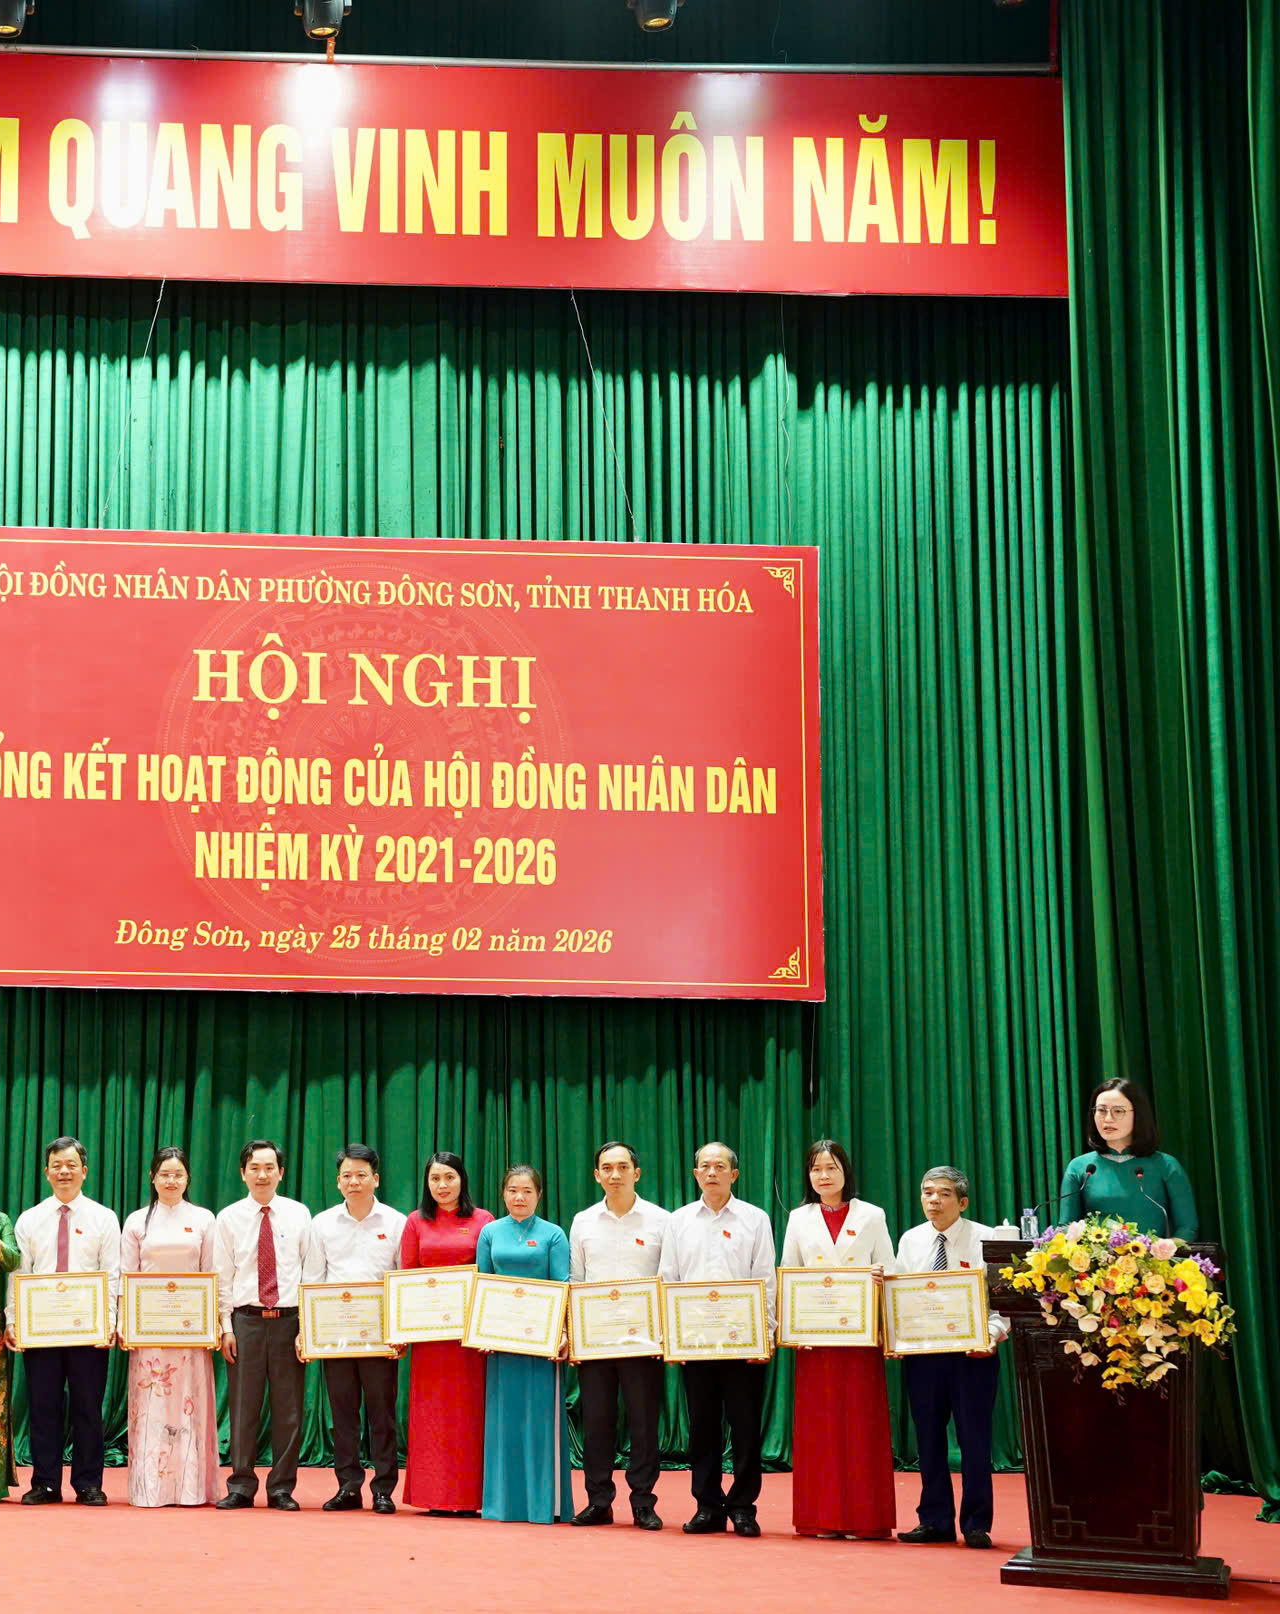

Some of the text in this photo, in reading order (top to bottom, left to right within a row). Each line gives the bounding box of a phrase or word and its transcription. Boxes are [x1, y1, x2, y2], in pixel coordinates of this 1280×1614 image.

[48, 116, 303, 240] QUANG
[330, 126, 508, 236] VINH
[537, 110, 764, 242] MUÔN
[793, 113, 998, 246] NĂM!
[29, 560, 108, 598] ĐỒNG
[112, 567, 191, 601] NHÂN
[195, 568, 252, 602] DÂN
[257, 569, 372, 607] PHƯỜNG
[377, 573, 455, 607] ĐÔNG
[460, 579, 521, 613] SƠN,
[526, 574, 592, 612] TỈNH
[597, 585, 692, 614] THANH
[697, 580, 754, 614] HÓA
[192, 632, 538, 725] HỘI NGHỊ
[63, 738, 127, 801] KẾT
[137, 754, 227, 814] HOẠT
[235, 747, 332, 816] ĐỘNG
[343, 743, 413, 808] CỦA
[423, 751, 481, 820] HỘI
[491, 746, 587, 812] ĐỒNG
[598, 755, 695, 814] NHÂN
[706, 757, 777, 815] DÂN
[195, 823, 557, 892] NHIỆM KỲ 2021-2026
[114, 920, 614, 957] Đông Sơn, ngày 25 tháng 02 năm 2026
